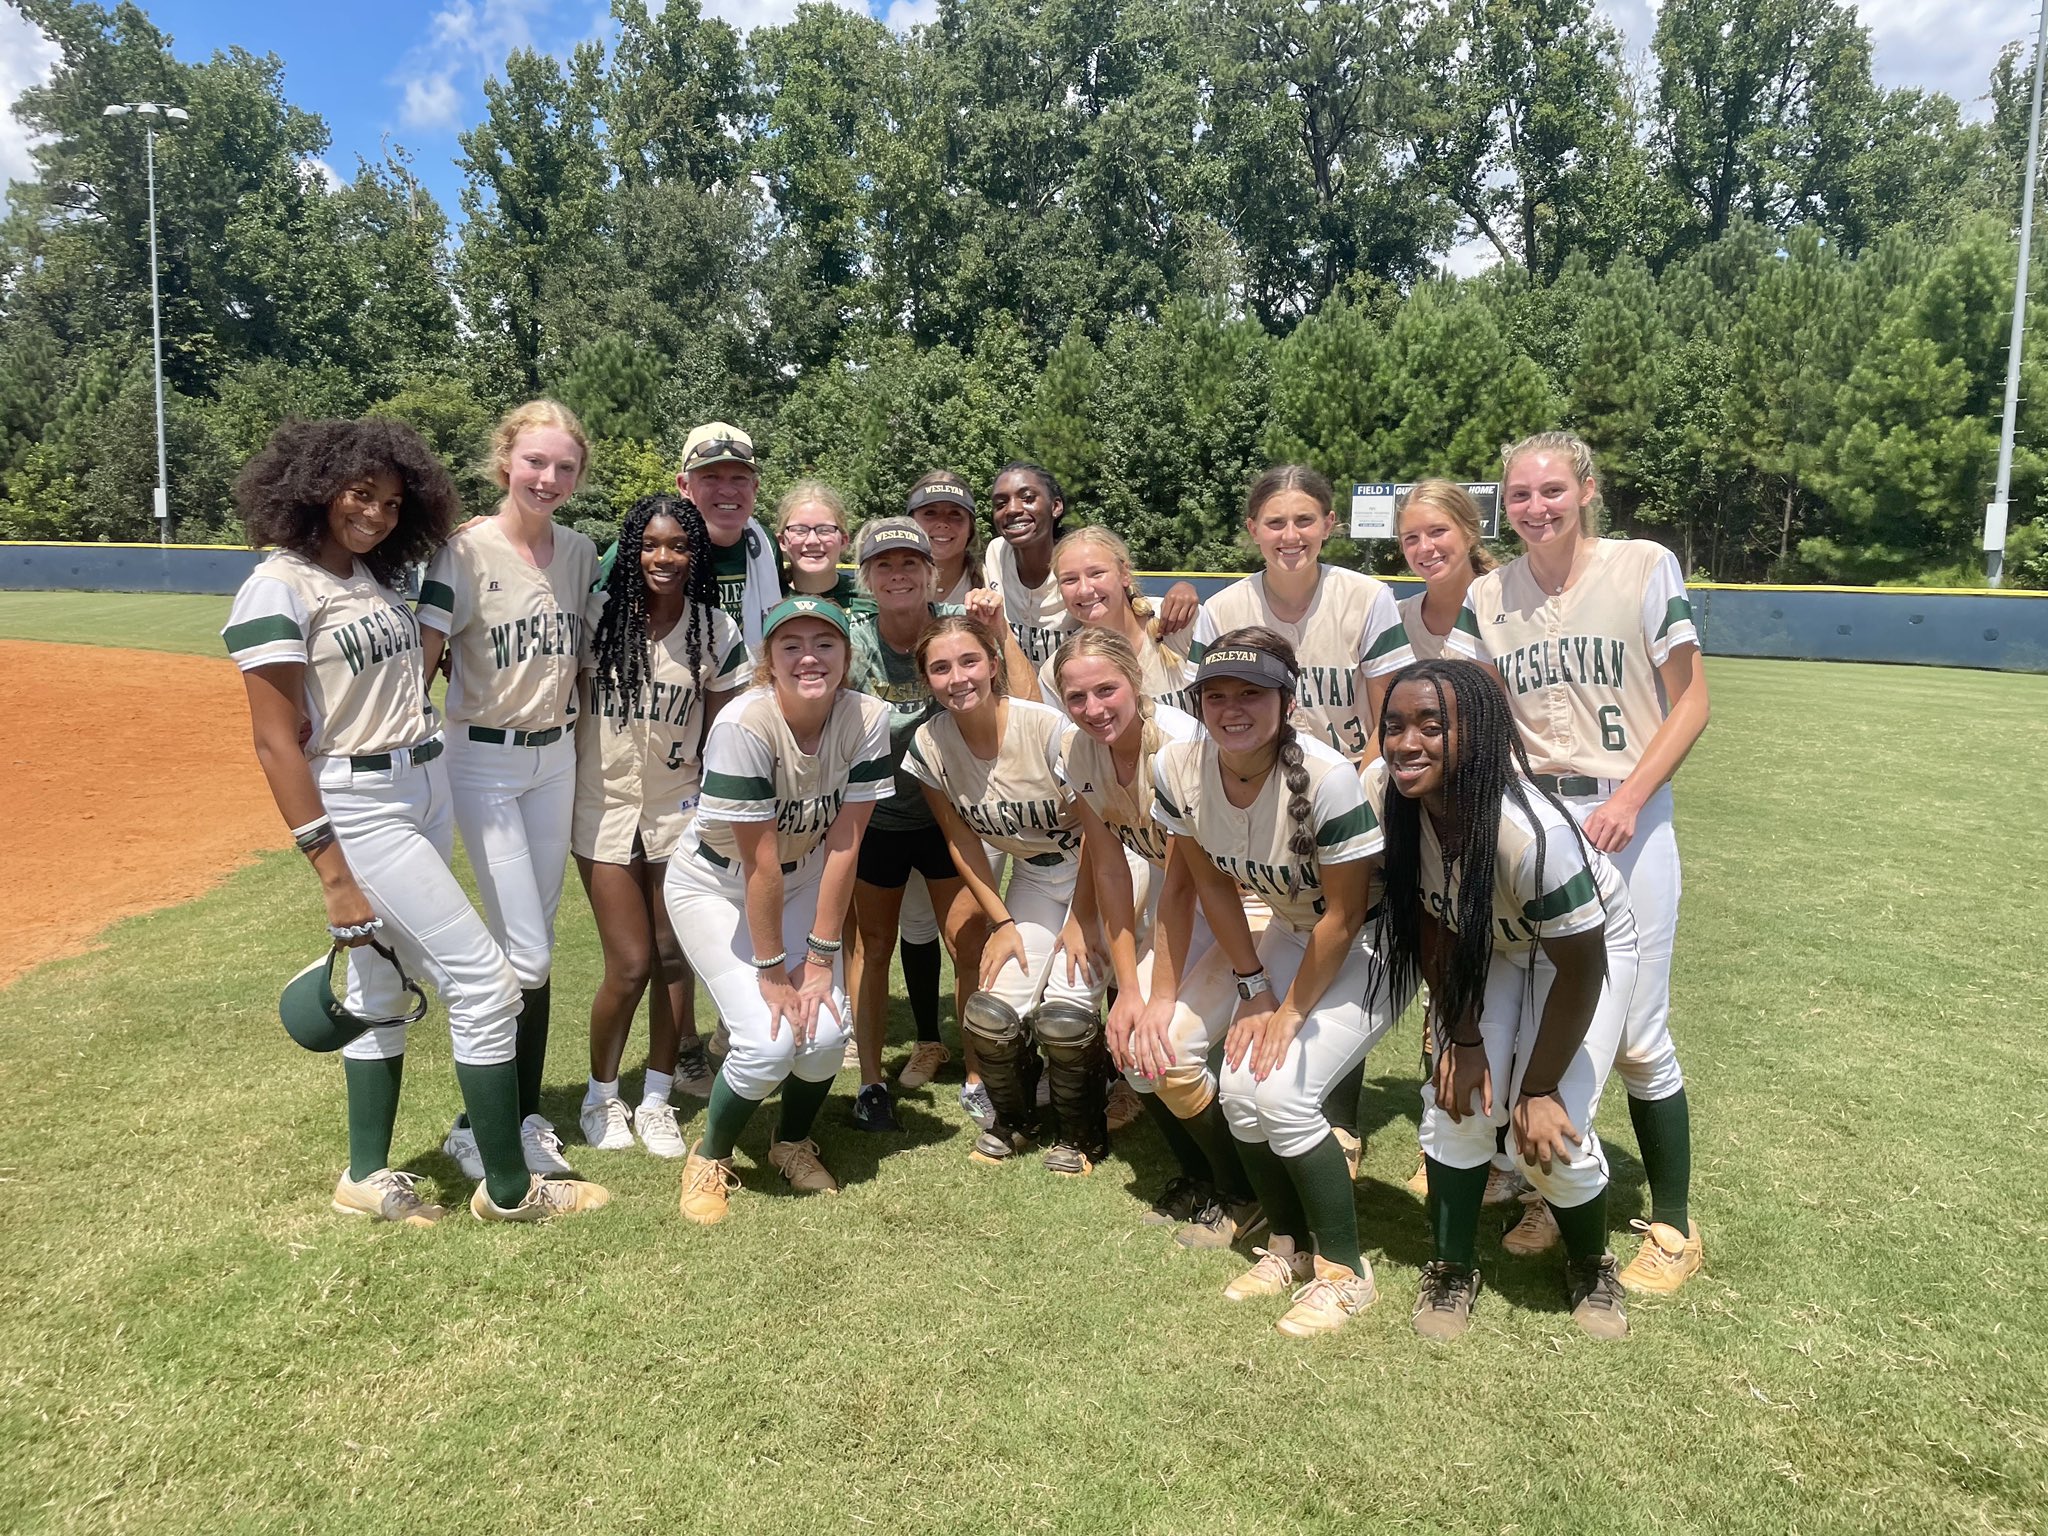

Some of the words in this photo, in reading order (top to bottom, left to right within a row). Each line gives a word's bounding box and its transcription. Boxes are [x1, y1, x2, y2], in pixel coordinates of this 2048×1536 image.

[925, 485, 964, 497] WESLEYAN
[1357, 486, 1384, 495] FIELD
[1384, 486, 1390, 495] 1
[1468, 485, 1496, 494] HOME
[875, 530, 920, 544] WESLEYAN
[793, 600, 818, 611] W
[332, 603, 423, 677] WESLEY
[1205, 650, 1257, 666] WESLEYAN
[1493, 636, 1625, 695] WESLEYAN
[1326, 715, 1367, 756] 13
[1598, 704, 1627, 752] 6
[666, 741, 685, 771] 5
